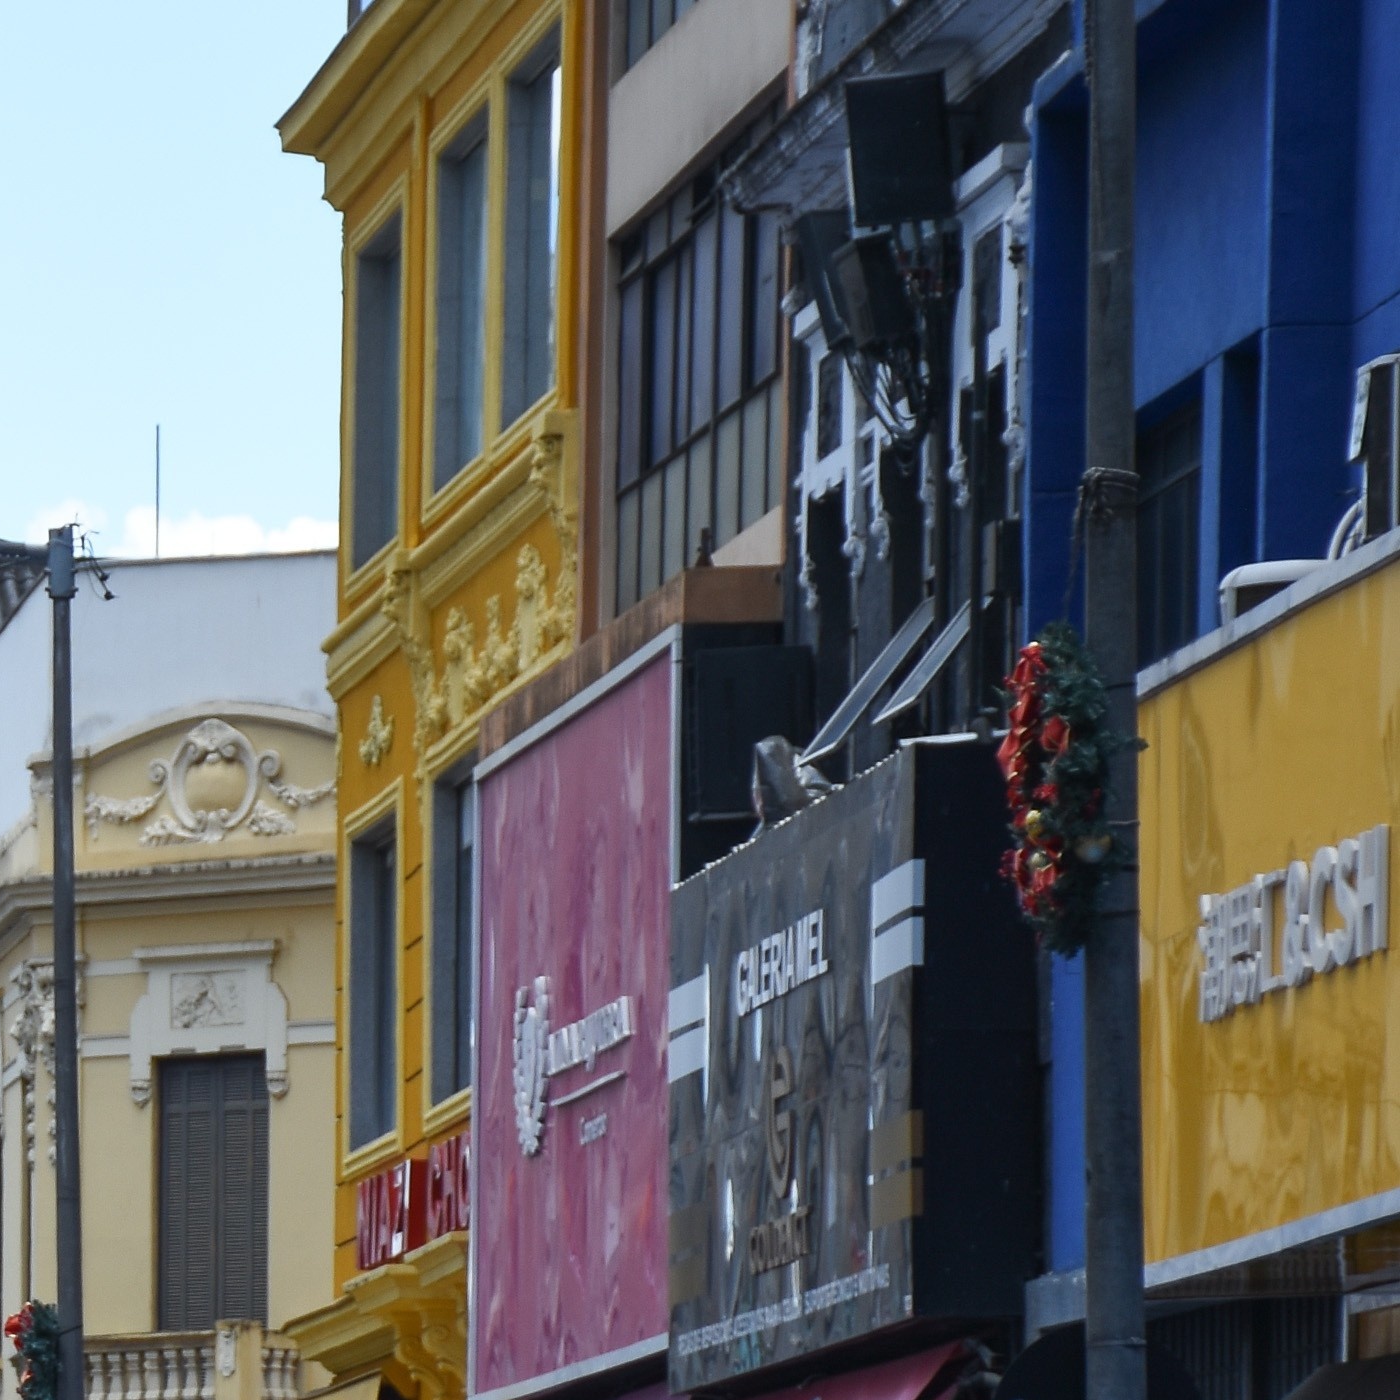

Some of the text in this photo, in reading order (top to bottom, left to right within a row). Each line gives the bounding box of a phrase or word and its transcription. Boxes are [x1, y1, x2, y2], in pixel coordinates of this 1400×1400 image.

[737, 909, 828, 1016] GALERIA MEL
[357, 1159, 411, 1270] NIAZI
